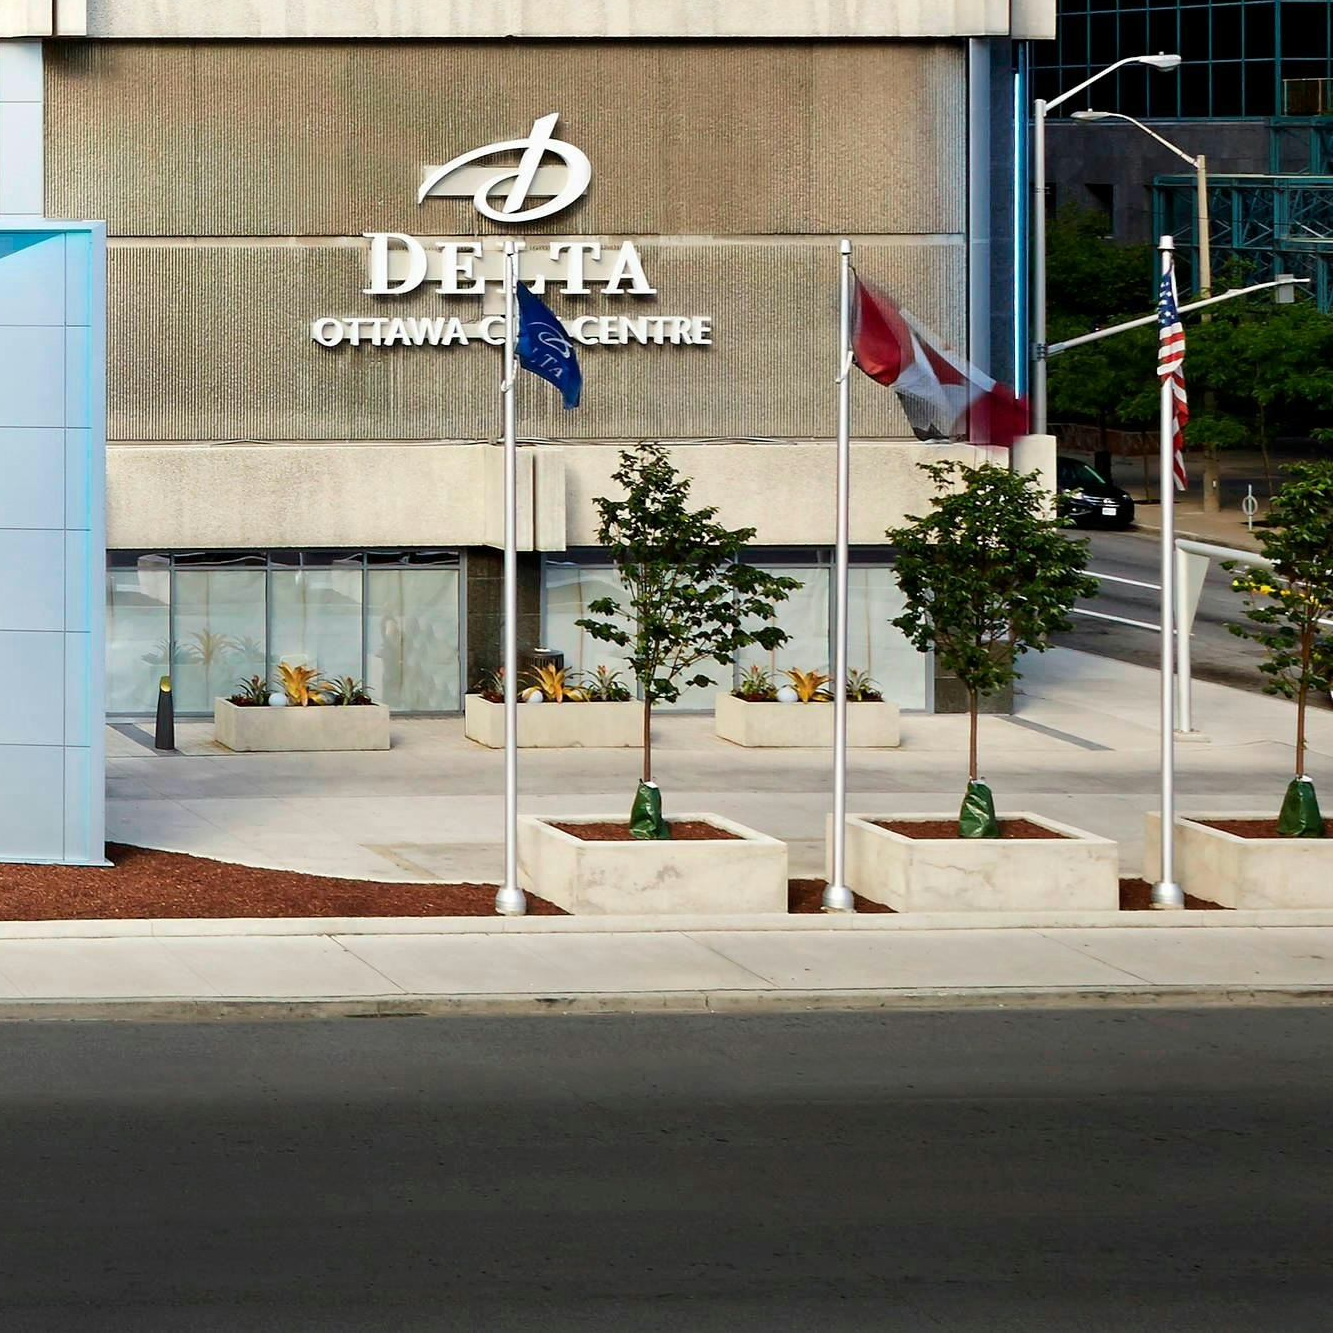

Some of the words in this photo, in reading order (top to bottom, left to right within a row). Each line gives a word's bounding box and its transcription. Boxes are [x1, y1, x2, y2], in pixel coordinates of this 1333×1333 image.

[362, 232, 657, 296] DELTA
[313, 317, 469, 347] OTTAWA
[573, 316, 712, 345] CENTRE
